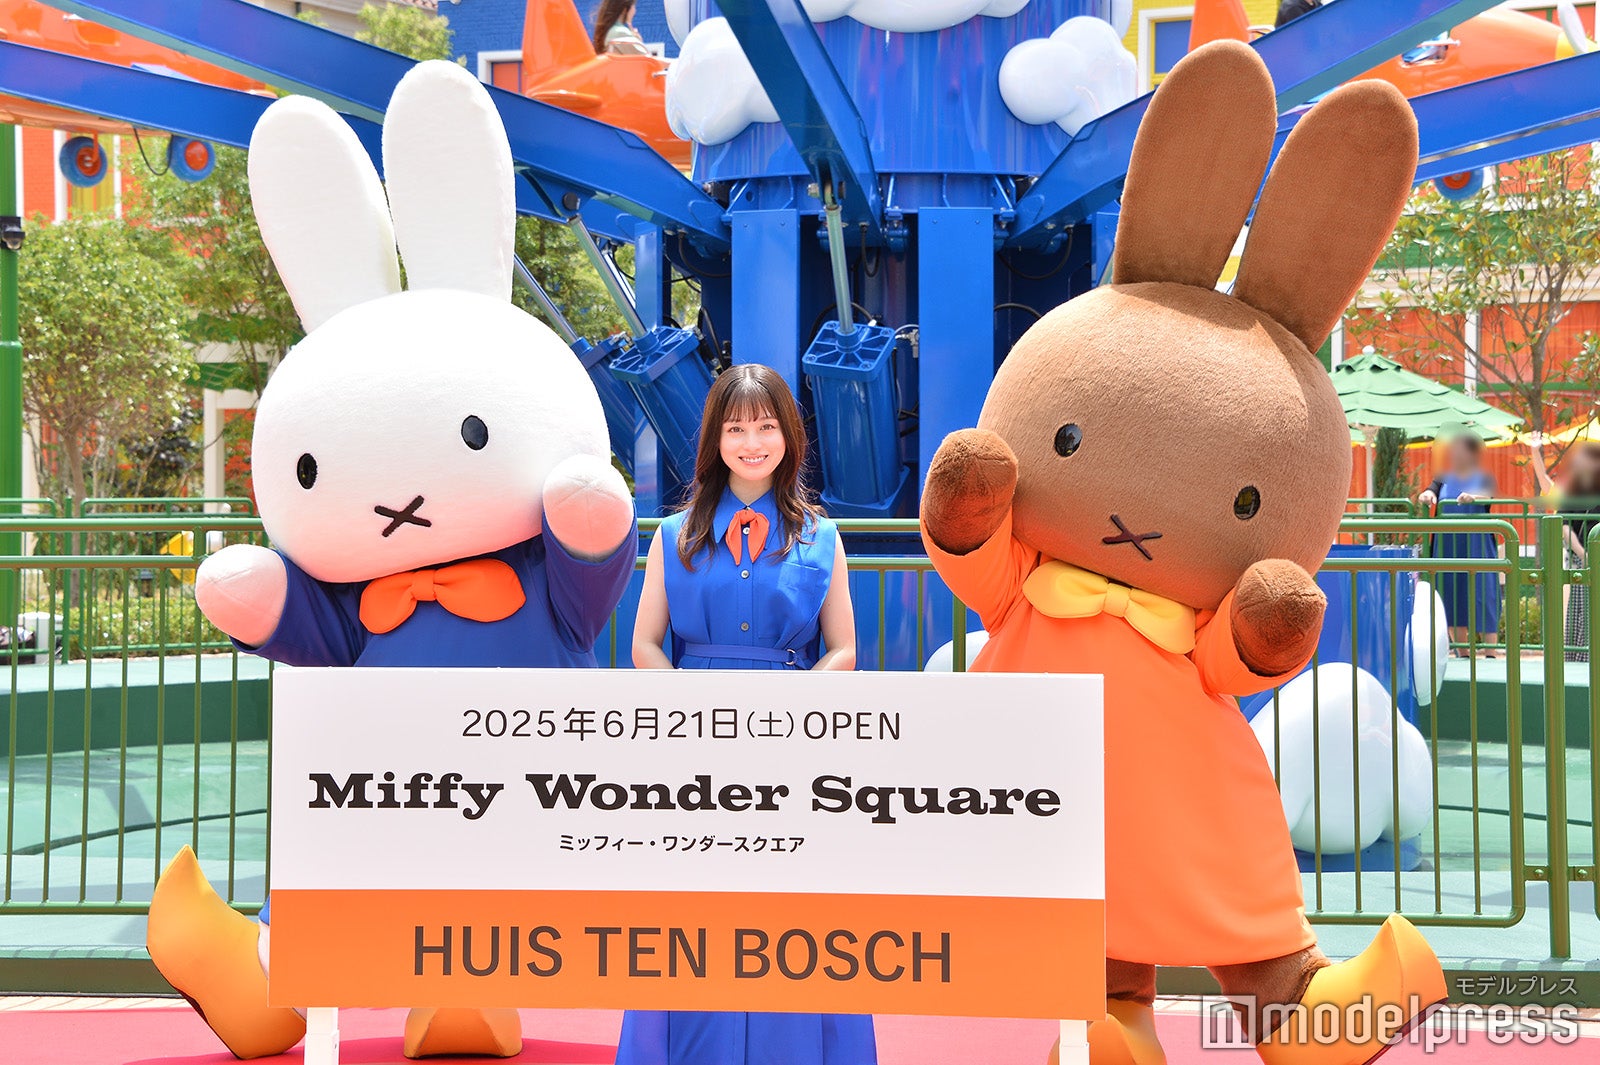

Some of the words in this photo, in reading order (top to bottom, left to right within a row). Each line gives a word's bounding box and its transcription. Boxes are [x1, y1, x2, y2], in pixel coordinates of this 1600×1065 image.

[803, 711, 901, 741] OPEN
[308, 771, 505, 821] Miffy
[525, 773, 789, 812] Wonder
[811, 774, 1061, 825] Square
[559, 834, 805, 853] ミッフィー・ワンダースクエア
[414, 925, 563, 978] HUIS
[584, 926, 707, 978] TEN
[734, 928, 952, 983] BOSCH
